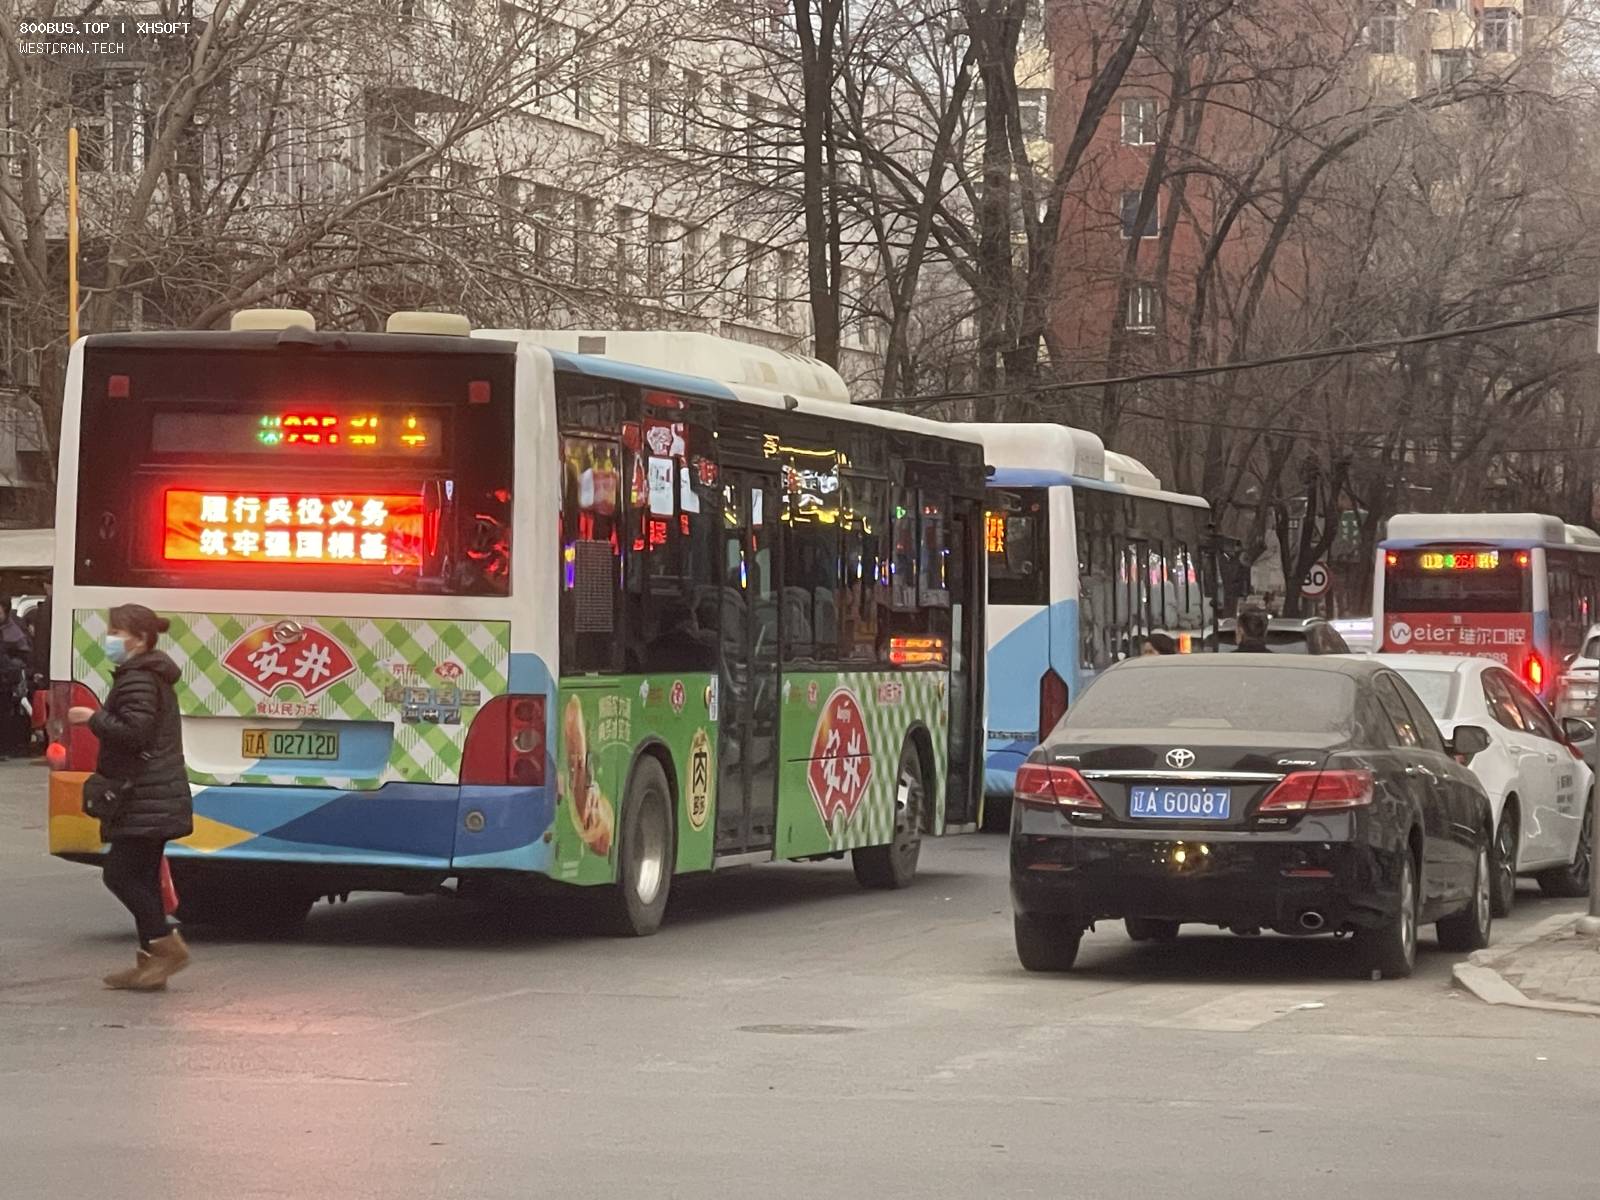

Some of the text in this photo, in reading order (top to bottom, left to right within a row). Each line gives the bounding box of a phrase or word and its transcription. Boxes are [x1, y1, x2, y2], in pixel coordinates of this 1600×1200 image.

[201, 495, 388, 526] 履行兵役义务
[200, 529, 387, 559] 筑牢强国根基
[1459, 627, 1526, 645] 维尔口腔
[248, 641, 331, 684] 安井
[274, 734, 336, 755] 02712D
[821, 727, 861, 806] 安井
